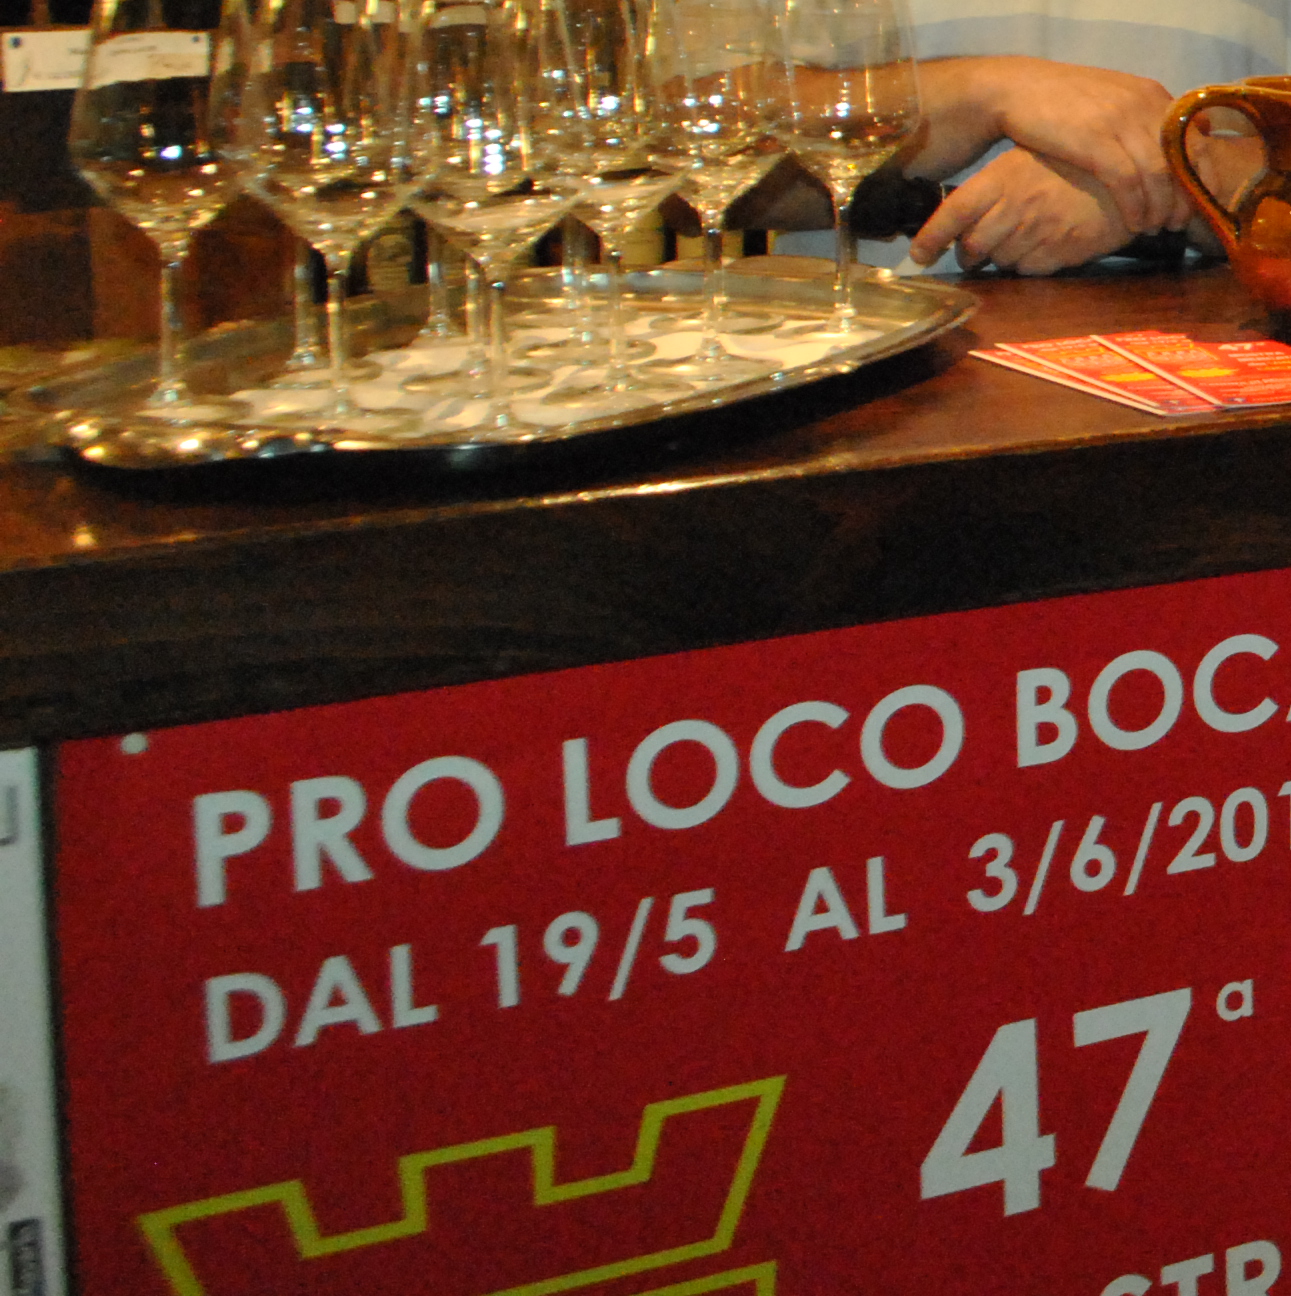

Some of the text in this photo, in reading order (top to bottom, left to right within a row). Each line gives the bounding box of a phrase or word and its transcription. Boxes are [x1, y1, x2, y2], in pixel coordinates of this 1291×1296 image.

[192, 754, 506, 909] PRO
[561, 683, 965, 847] LOCO
[203, 944, 440, 1065] DAL
[479, 887, 718, 1002] 19/5
[783, 854, 908, 952] AL
